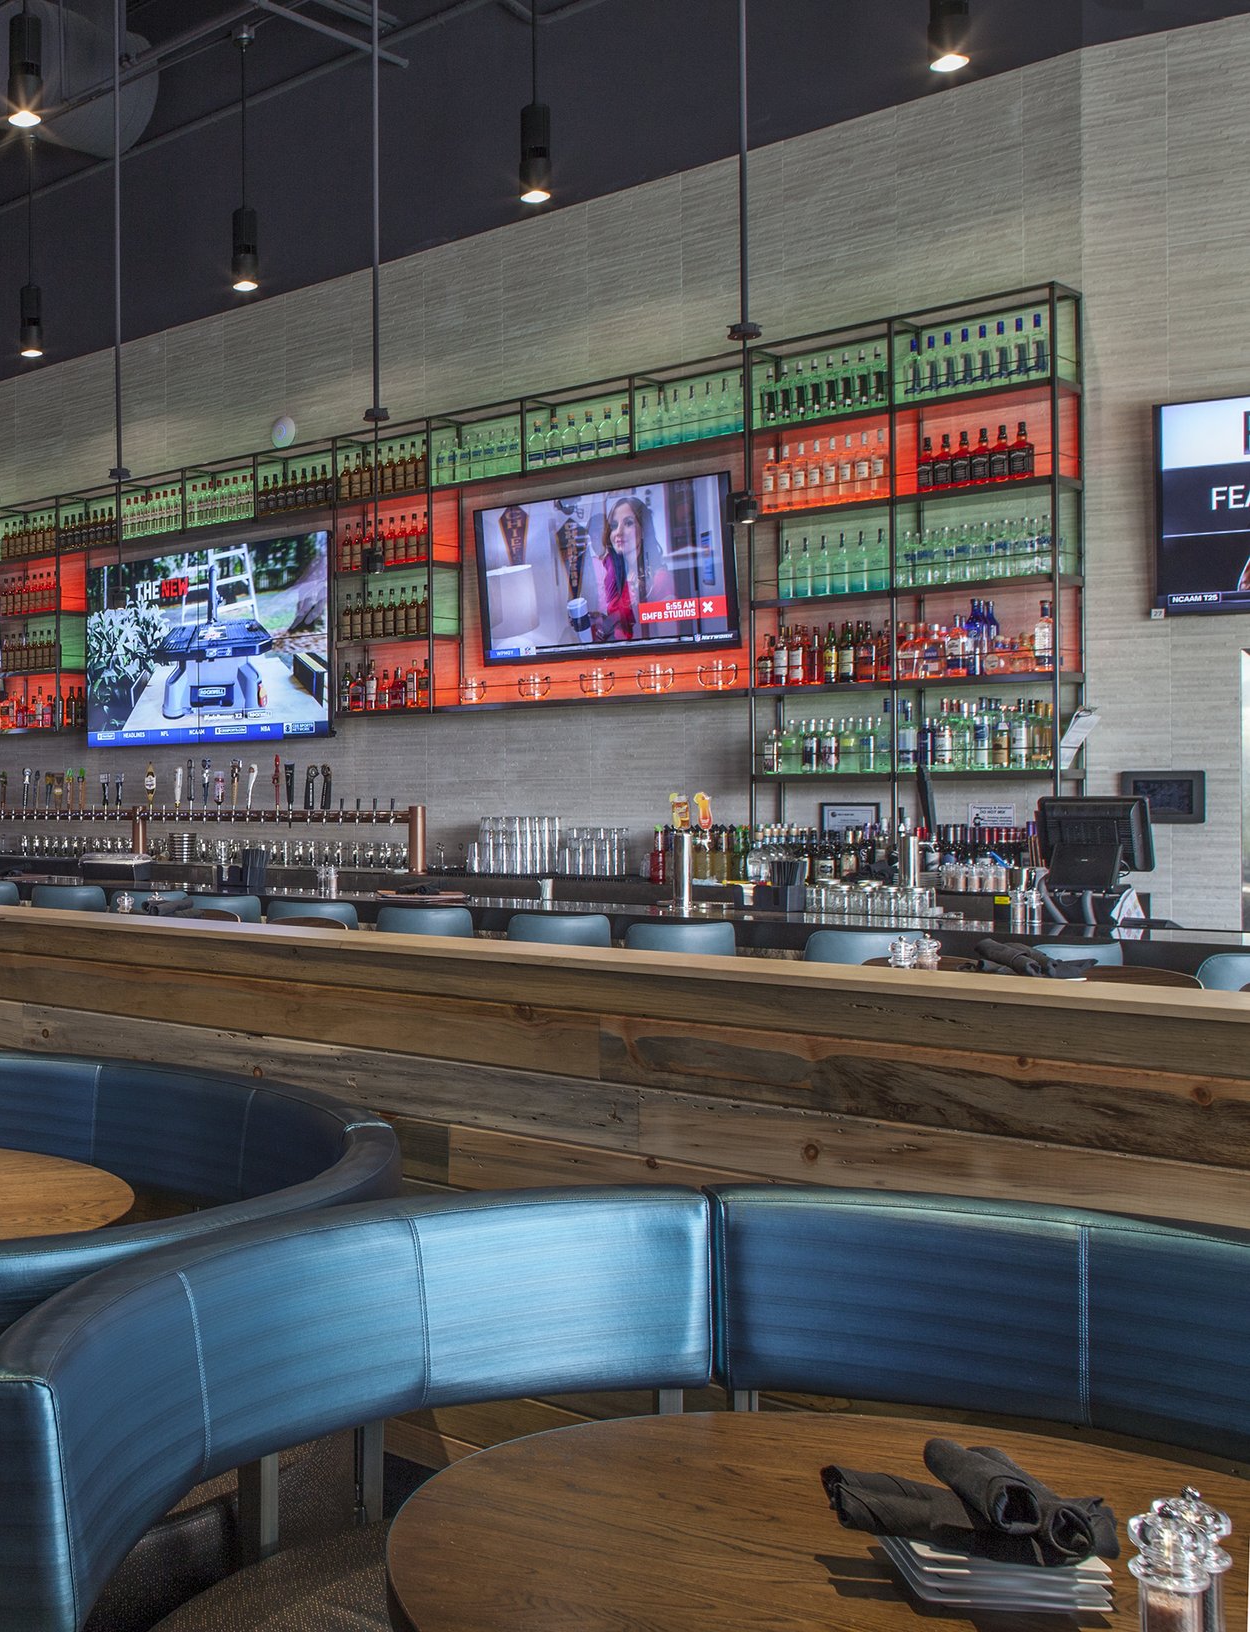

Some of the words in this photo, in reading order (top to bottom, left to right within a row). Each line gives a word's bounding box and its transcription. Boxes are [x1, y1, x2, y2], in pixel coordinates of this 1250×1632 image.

[135, 580, 161, 601] THE
[161, 576, 189, 598] NEW
[1203, 594, 1218, 602] T25
[666, 602, 682, 611] 6:55
[684, 600, 696, 609] AM
[642, 610, 663, 620] GMFB
[663, 609, 696, 619] STUDIOS
[701, 633, 734, 641] NETWORK
